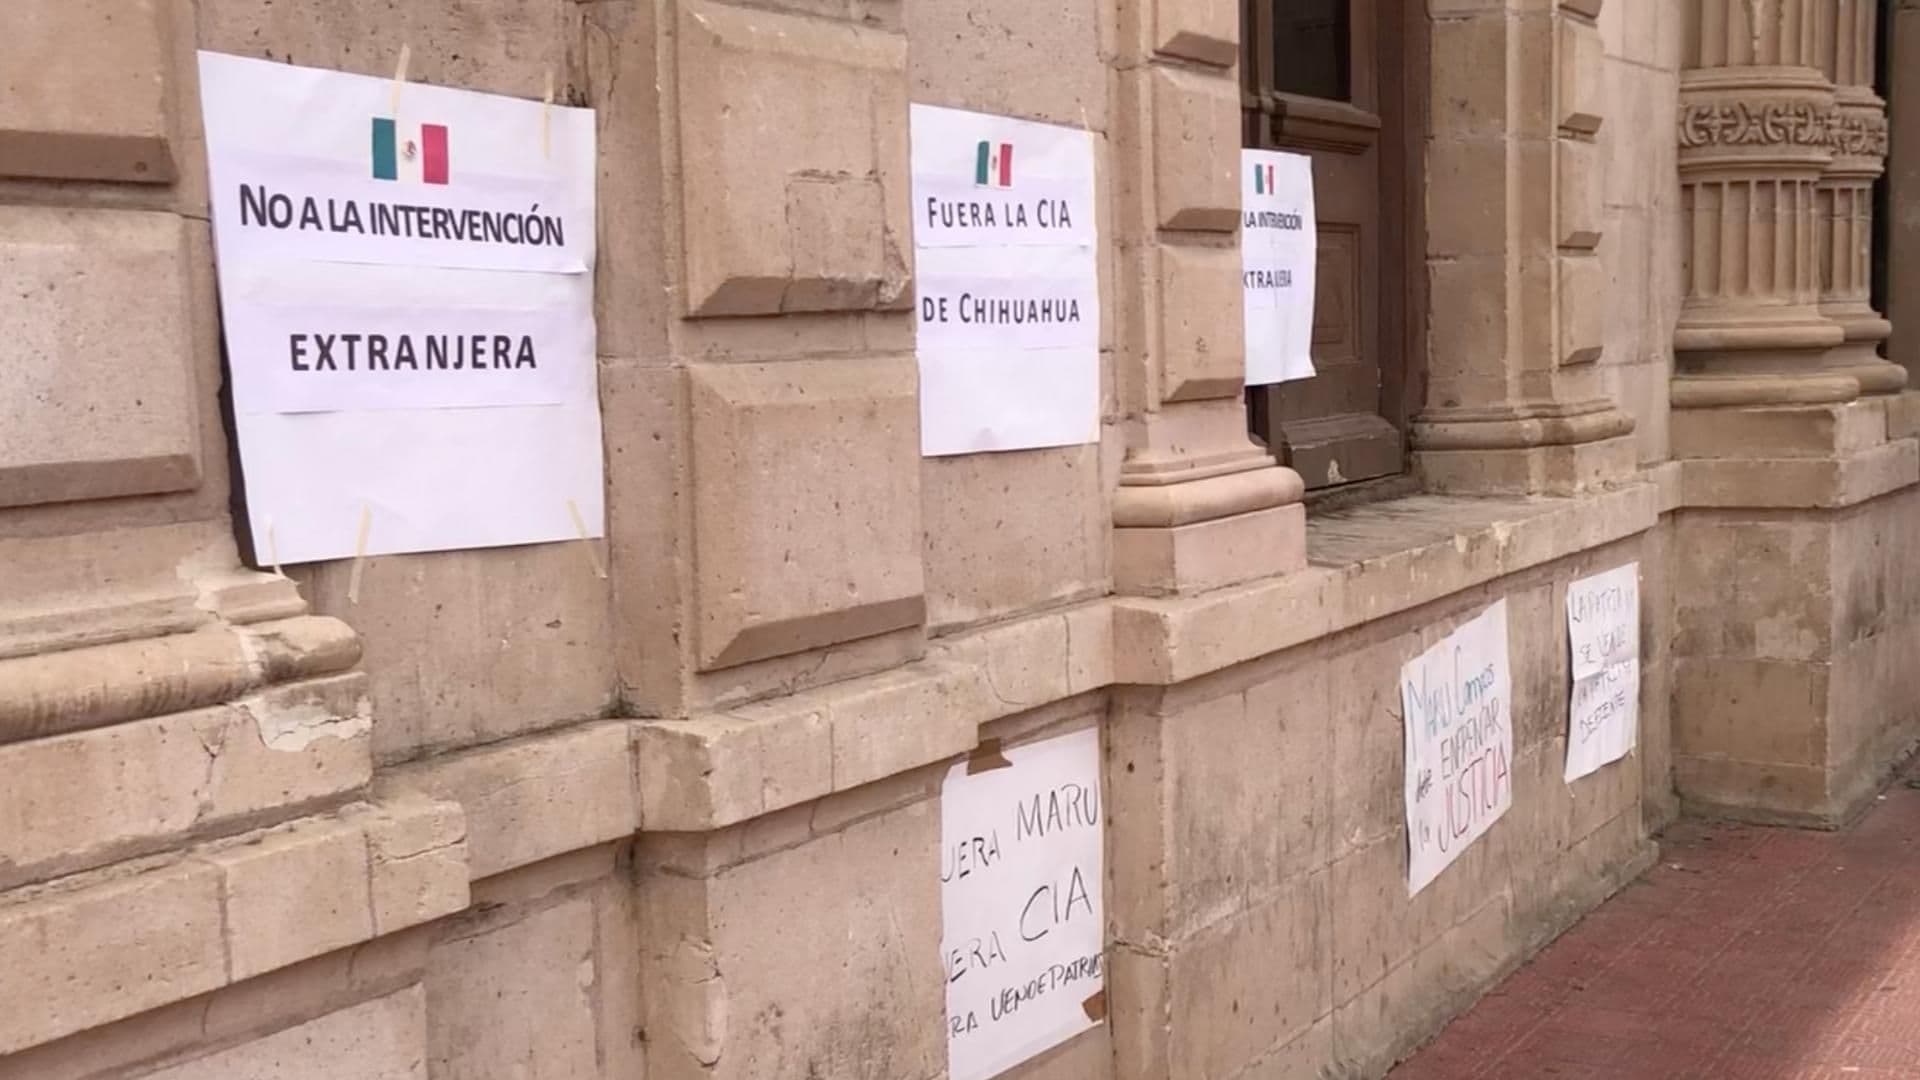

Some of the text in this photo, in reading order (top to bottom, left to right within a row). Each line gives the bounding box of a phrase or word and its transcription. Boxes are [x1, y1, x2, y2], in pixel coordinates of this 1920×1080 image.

[299, 197, 323, 231] A
[329, 199, 364, 234] LA
[371, 203, 564, 246] INTERVENCIÓN
[928, 197, 1072, 228] FUERA LA CIA
[1244, 212, 1256, 228] LA
[922, 293, 1080, 324] DE CHIHUAHUA
[290, 333, 537, 371] EXTRANJERA
[1438, 741, 1509, 853] JUSTICIA
[941, 780, 1098, 883] UERA MARU
[946, 866, 1092, 983] ERA CIA
